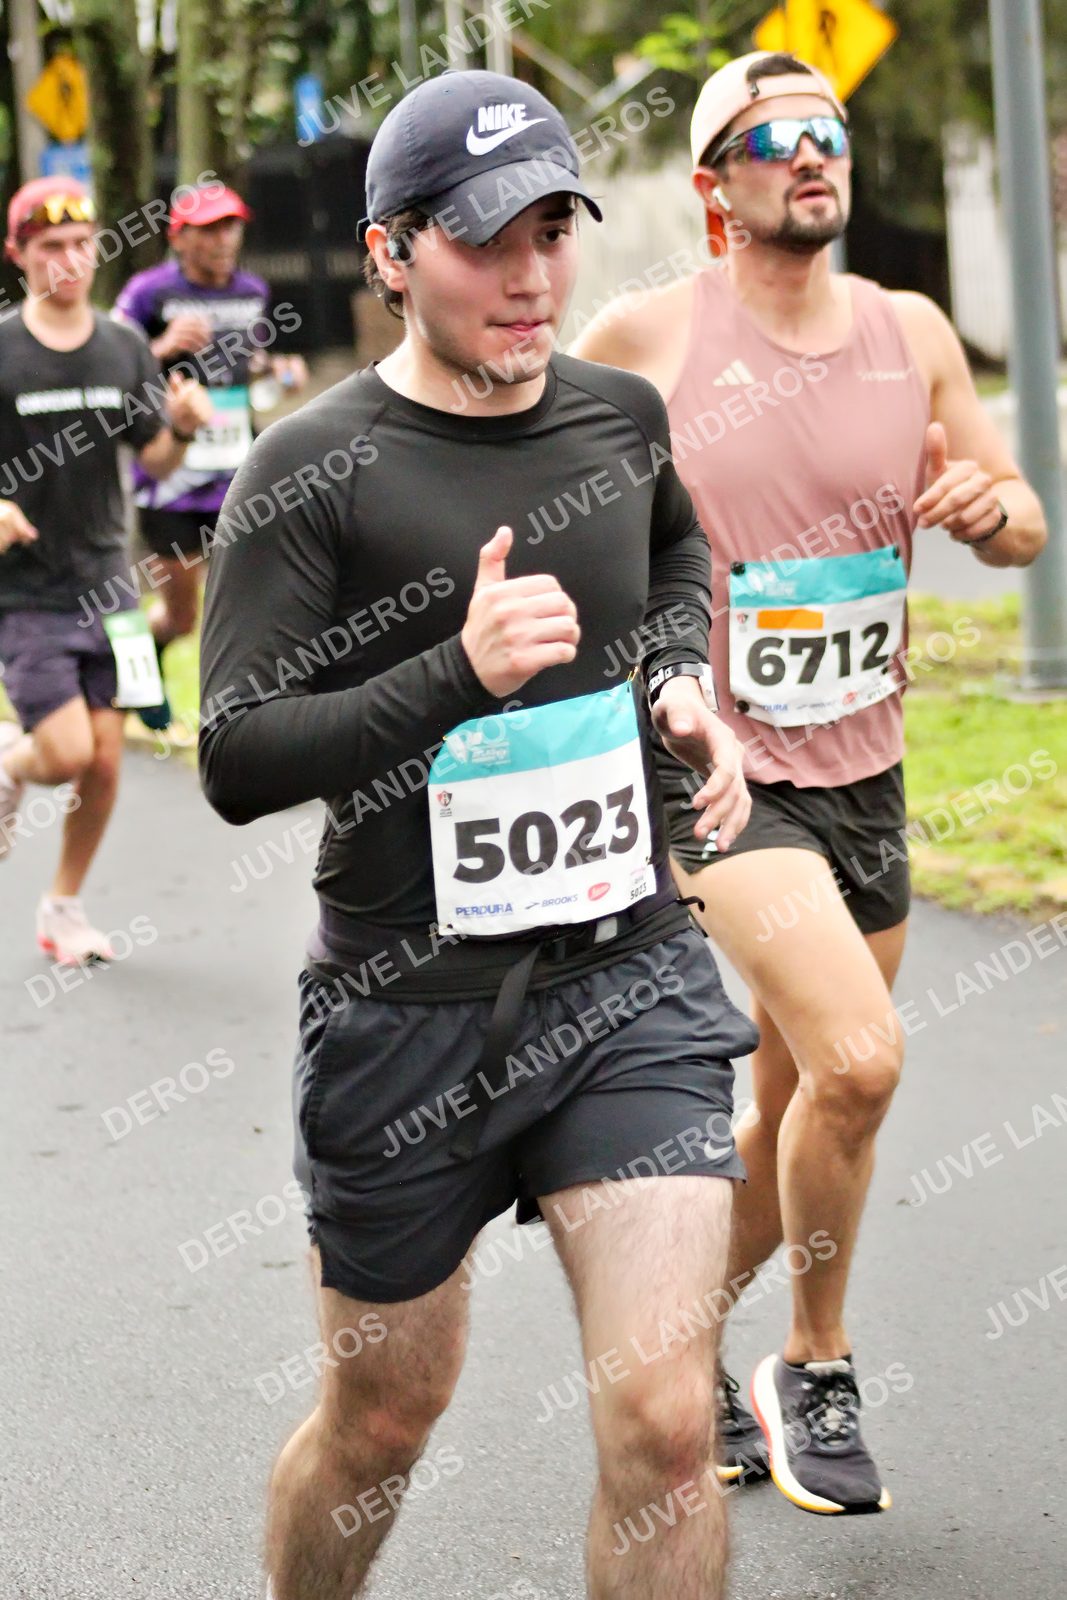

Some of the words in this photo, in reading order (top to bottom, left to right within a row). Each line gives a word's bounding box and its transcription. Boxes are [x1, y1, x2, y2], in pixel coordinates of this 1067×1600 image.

[478, 103, 527, 133] NIKE
[747, 621, 889, 686] 6712
[453, 783, 639, 884] 5023
[455, 902, 514, 916] PERDURA
[541, 893, 579, 907] BROOKS
